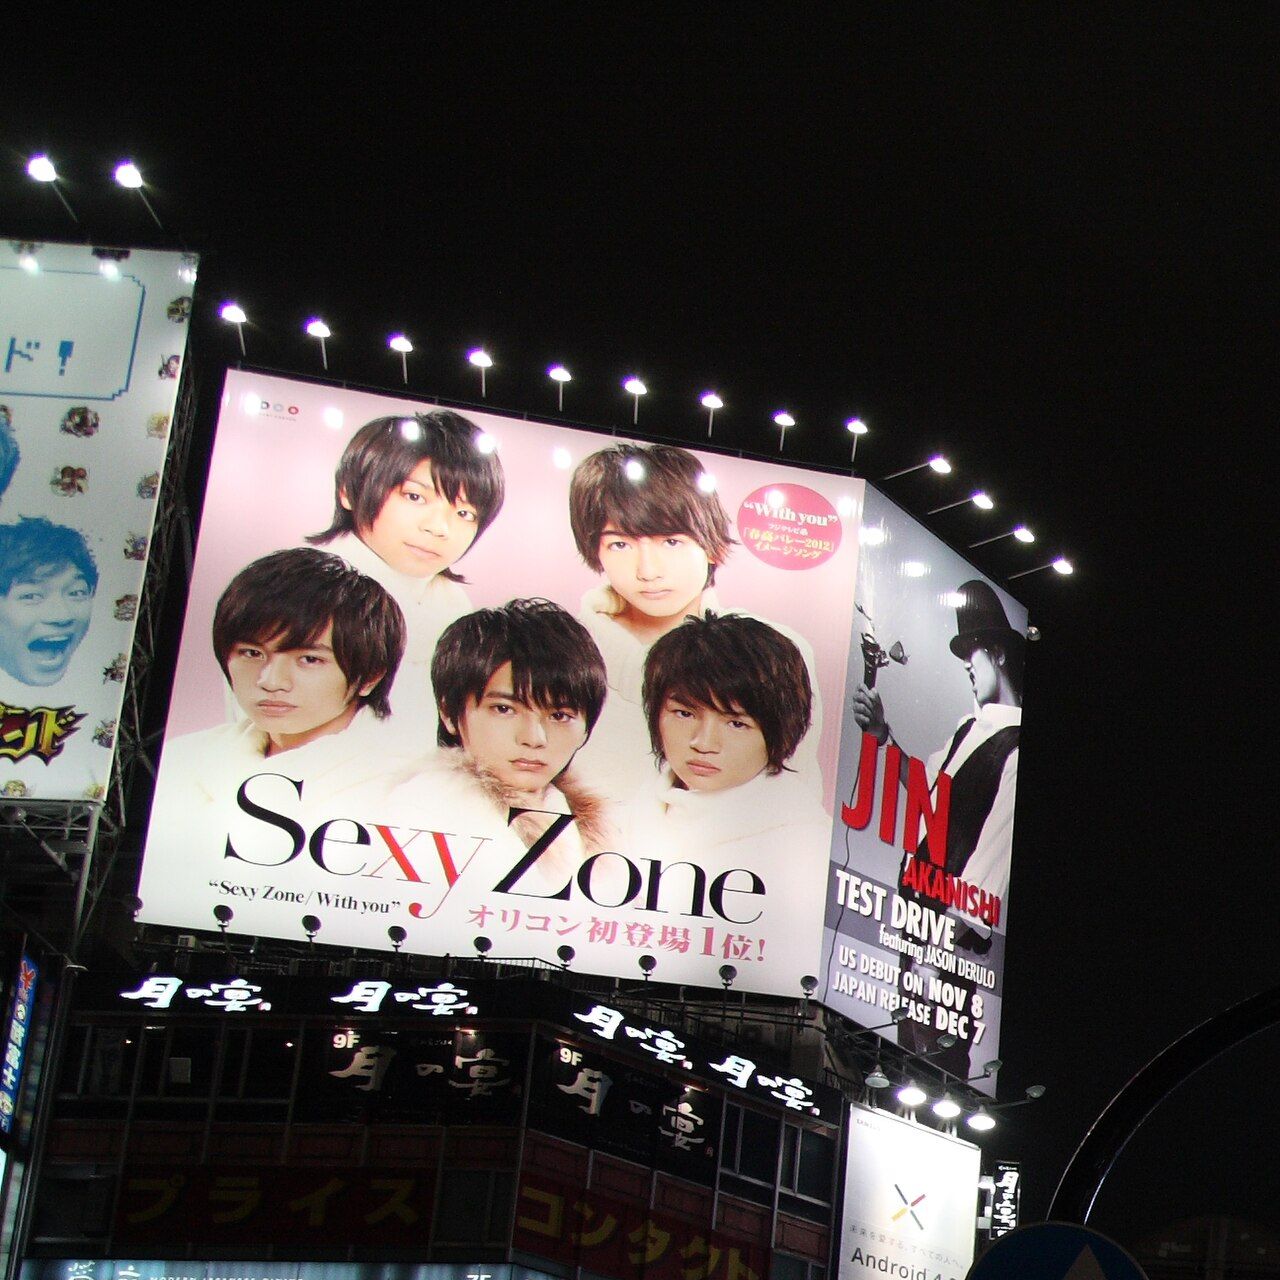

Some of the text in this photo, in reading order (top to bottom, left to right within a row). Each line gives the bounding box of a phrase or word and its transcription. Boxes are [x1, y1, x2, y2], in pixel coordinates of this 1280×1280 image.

[841, 731, 953, 868] JIN
[223, 772, 767, 925] Sexy Zone
[317, 890, 358, 913] With
[836, 868, 957, 953] TEST DRIVE
[902, 864, 1003, 927] AKANISHI
[838, 944, 985, 1020] US DEBUT ON NOV 8
[878, 925, 997, 990] featuring JASON DERULO
[332, 1033, 362, 1049] 9F
[832, 971, 877, 1010] JAPAN
[935, 1002, 969, 1039] DEC
[973, 1020, 987, 1046] 7
[559, 1047, 583, 1067] 9F
